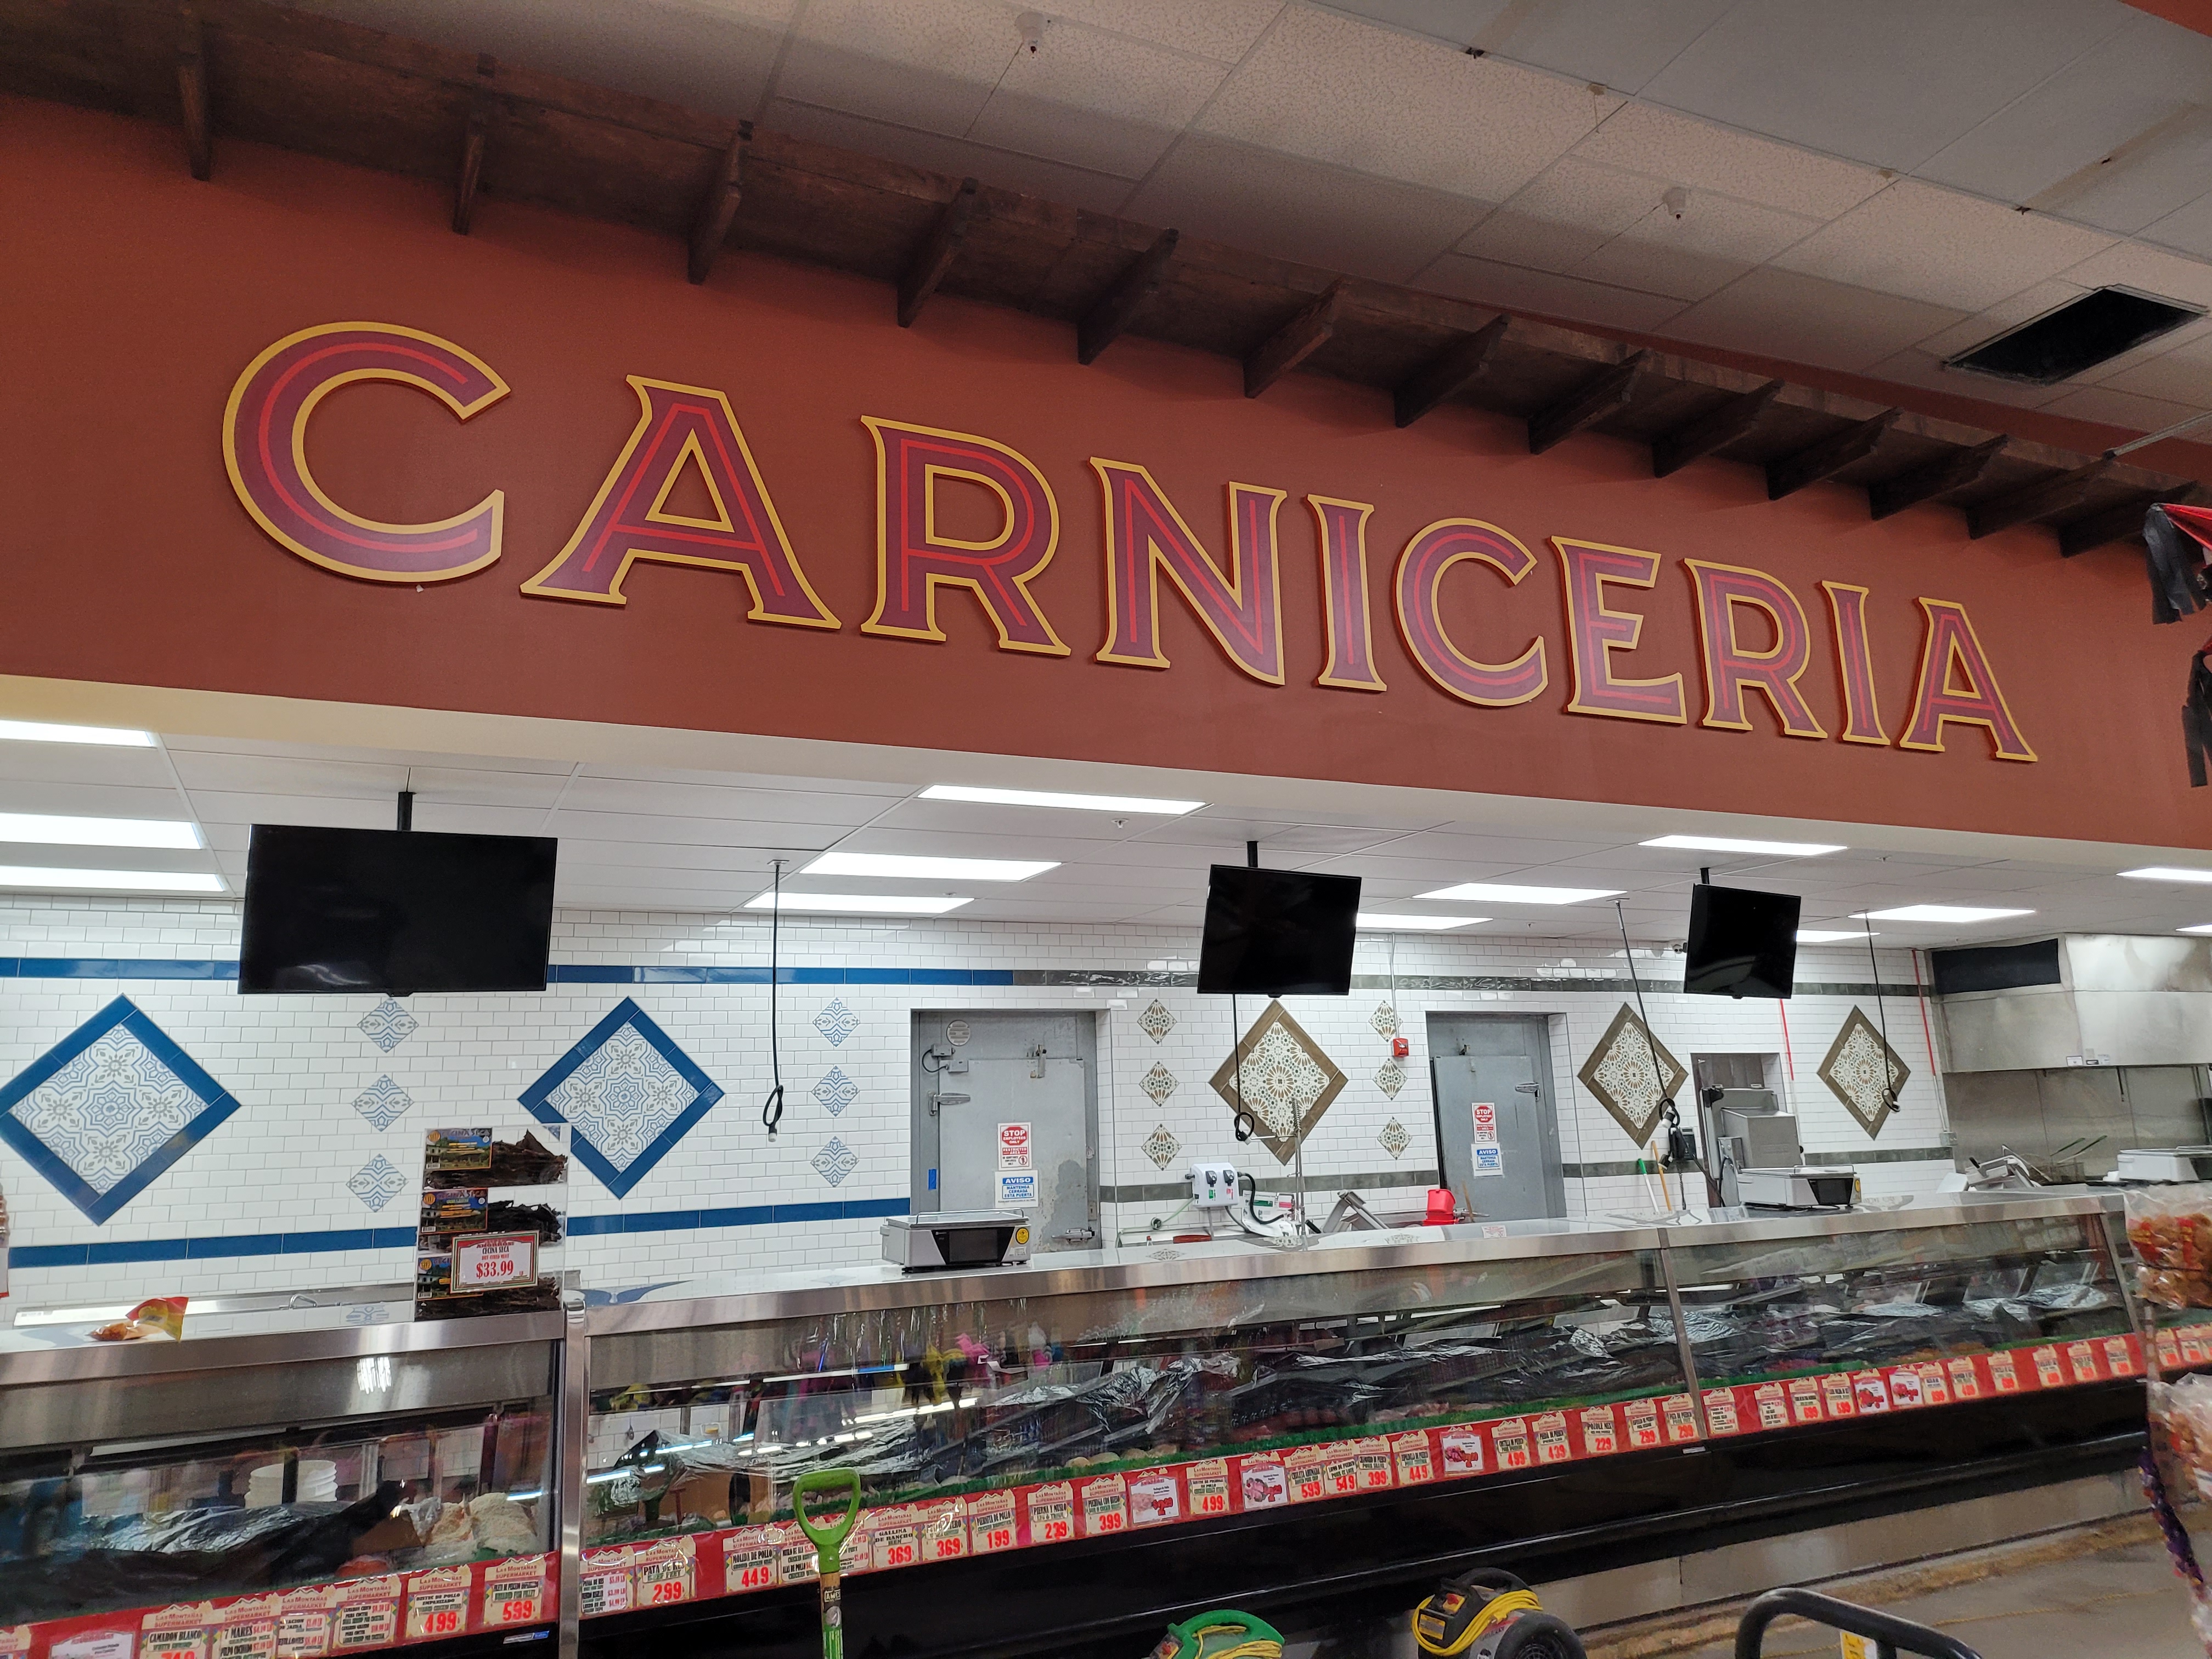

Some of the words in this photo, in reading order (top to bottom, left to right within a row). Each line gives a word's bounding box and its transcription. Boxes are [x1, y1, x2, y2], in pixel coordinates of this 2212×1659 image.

[222, 320, 2038, 762] CARNICERIA
[476, 1260, 514, 1279] $33.99
[1548, 1444, 1566, 1459] 439
[1595, 1437, 1612, 1451] 229
[1508, 1452, 1525, 1466] 499
[1368, 1470, 1386, 1486] 399
[1410, 1465, 1428, 1481] 449
[1301, 1481, 1321, 1498] 599
[1336, 1475, 1355, 1491] 549
[1090, 1487, 1119, 1496] SUPERMARKET
[1036, 1496, 1066, 1504] SUPERMARKET
[1202, 1495, 1224, 1512] 499
[994, 1514, 998, 1522] DE
[999, 1510, 1011, 1521] POLLO
[1034, 1505, 1049, 1515] PIERNA
[1054, 1503, 1066, 1511] MUSLO
[1099, 1513, 1122, 1531] 399
[885, 1533, 913, 1542] RANCHO
[986, 1530, 1010, 1549] 199
[887, 1545, 912, 1565] 369
[937, 1538, 961, 1557] 369
[732, 1553, 750, 1563] MOLIDA
[751, 1551, 757, 1560] DE
[758, 1549, 772, 1559] POLLO
[495, 1571, 537, 1579] SUPERMARKET
[644, 1564, 660, 1576] PATA
[673, 1561, 684, 1571] RES
[741, 1566, 769, 1588] 449
[419, 1582, 461, 1590] SUPERMARKET
[653, 1582, 682, 1602] 299
[347, 1592, 391, 1600] SUPERMARKET
[225, 1612, 271, 1622] SUPERMARKET
[503, 1600, 533, 1621] 599
[424, 1612, 457, 1633] 499
[150, 1632, 178, 1643] CAMARON
[179, 1630, 202, 1640] BLANCO
[224, 1629, 229, 1639] 7
[231, 1626, 252, 1638] MARES
